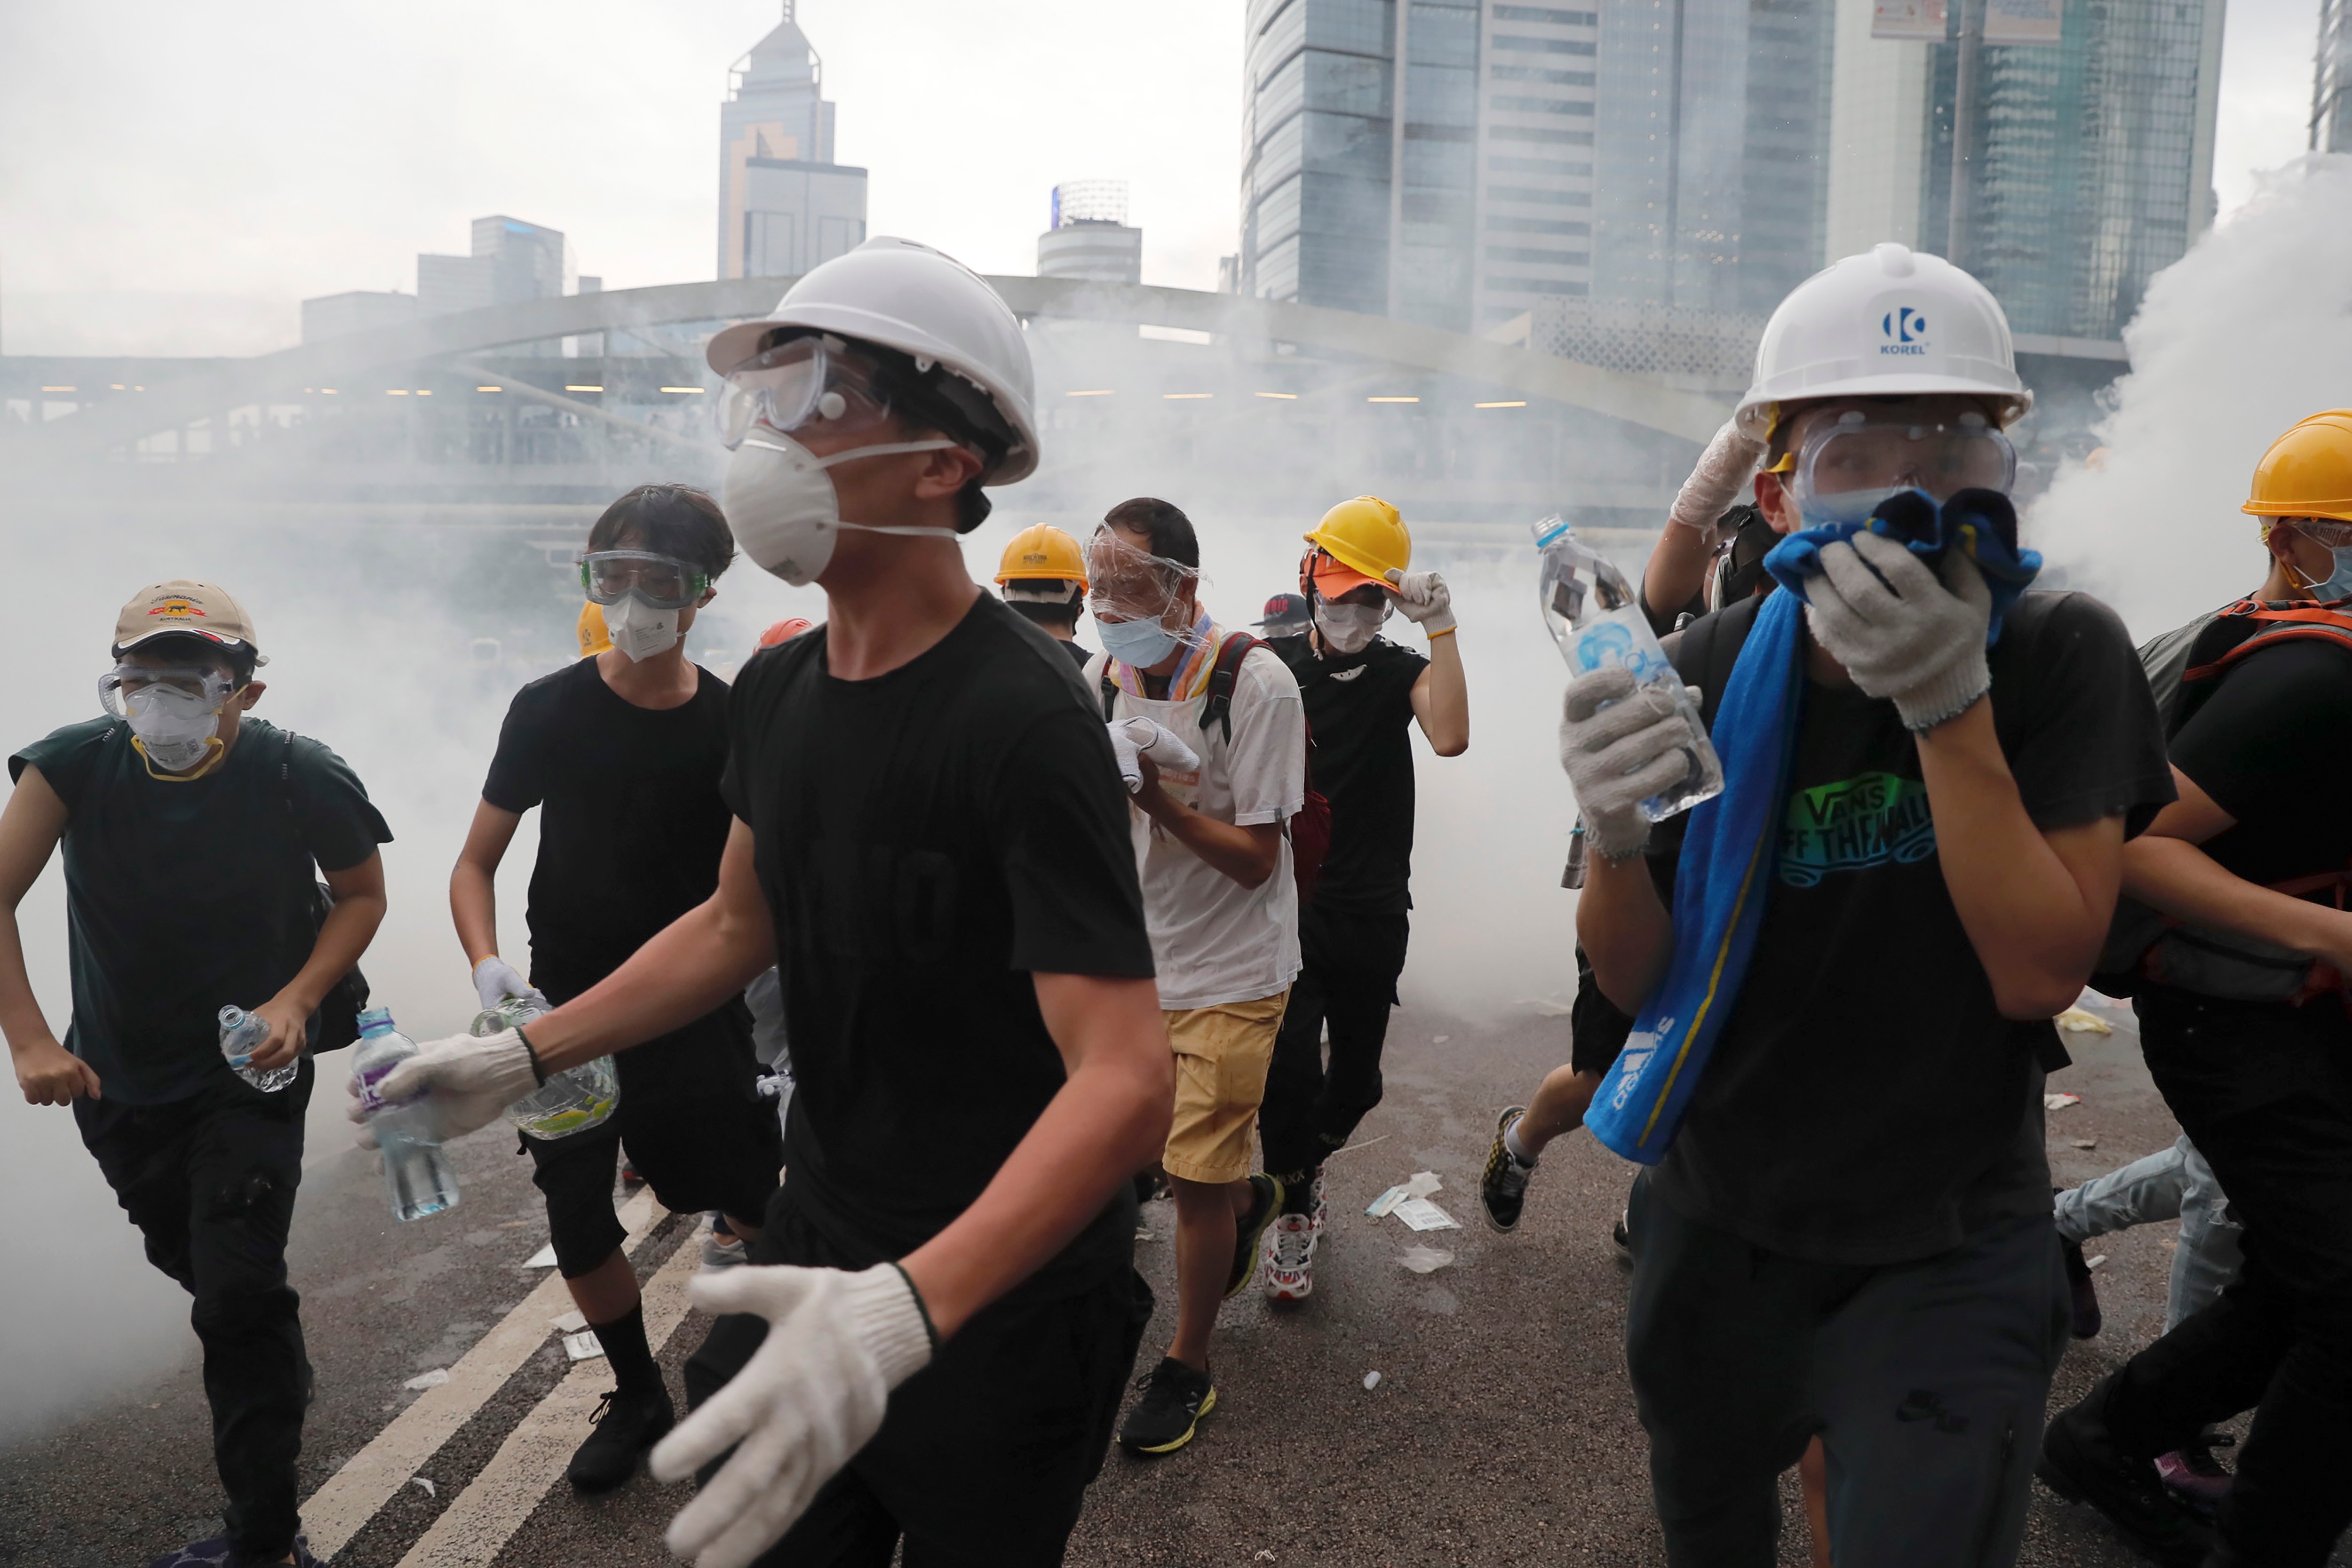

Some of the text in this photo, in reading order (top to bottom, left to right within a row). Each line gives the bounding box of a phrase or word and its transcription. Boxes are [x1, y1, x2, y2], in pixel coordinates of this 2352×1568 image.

[1880, 345, 1925, 355] KOREL
[151, 594, 204, 605] Tasmania
[1804, 775, 1884, 826] VANS
[1782, 828, 1809, 859] FF
[1815, 814, 1872, 862] THE
